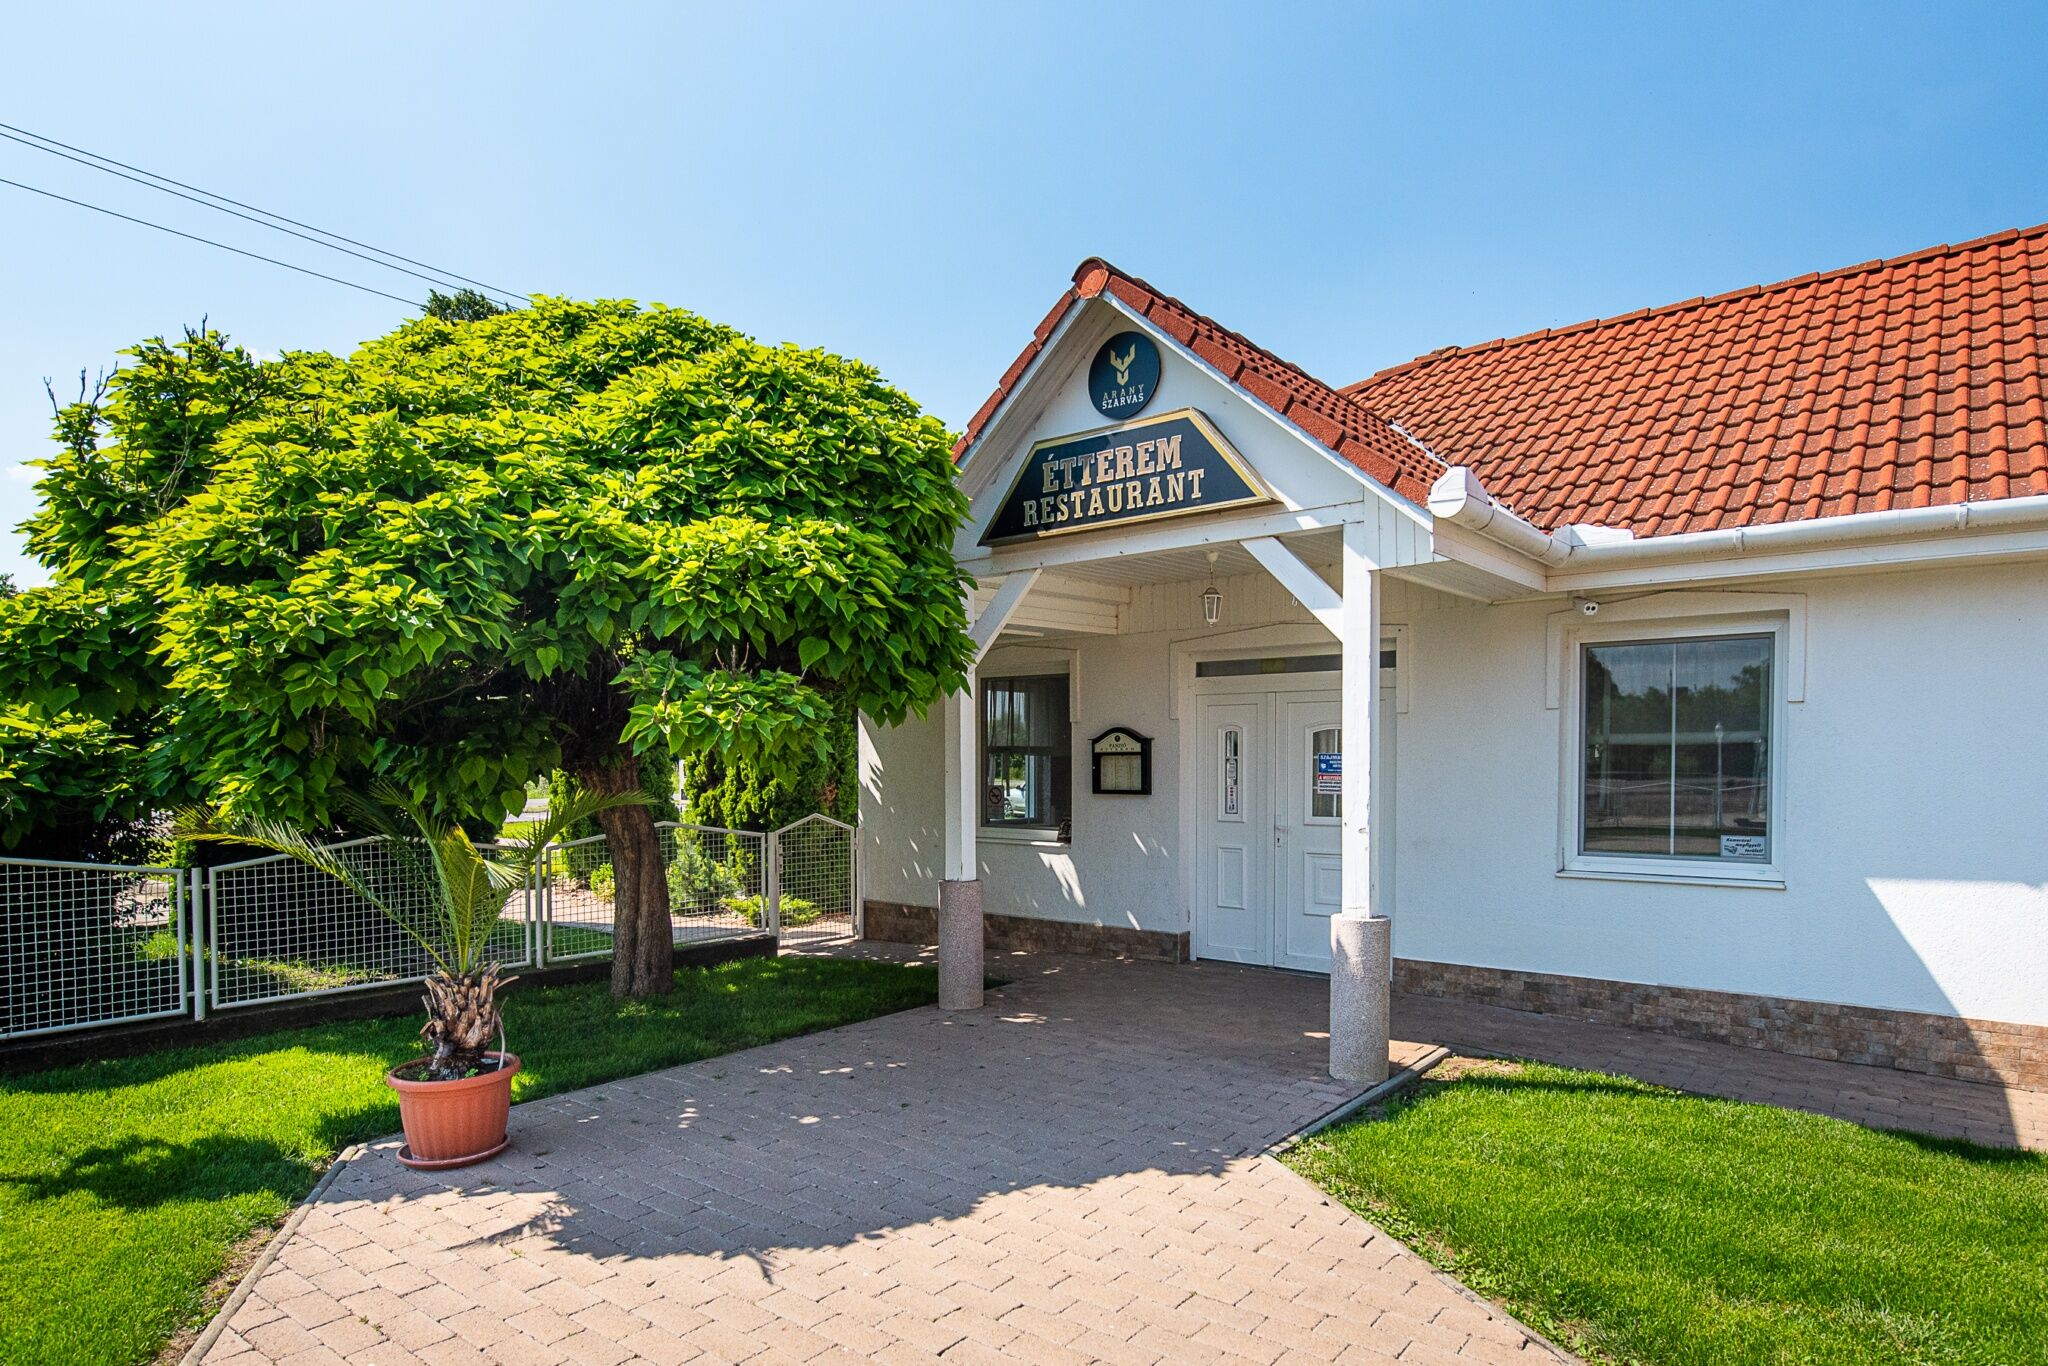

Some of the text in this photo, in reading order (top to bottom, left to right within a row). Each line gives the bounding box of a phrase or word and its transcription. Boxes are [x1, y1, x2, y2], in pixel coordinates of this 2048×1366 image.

[1102, 393, 1144, 410] SZARVAS
[1103, 384, 1144, 400] ARANY
[1042, 434, 1183, 493] ÉTTEREM
[1023, 468, 1205, 527] RESTAURANT
